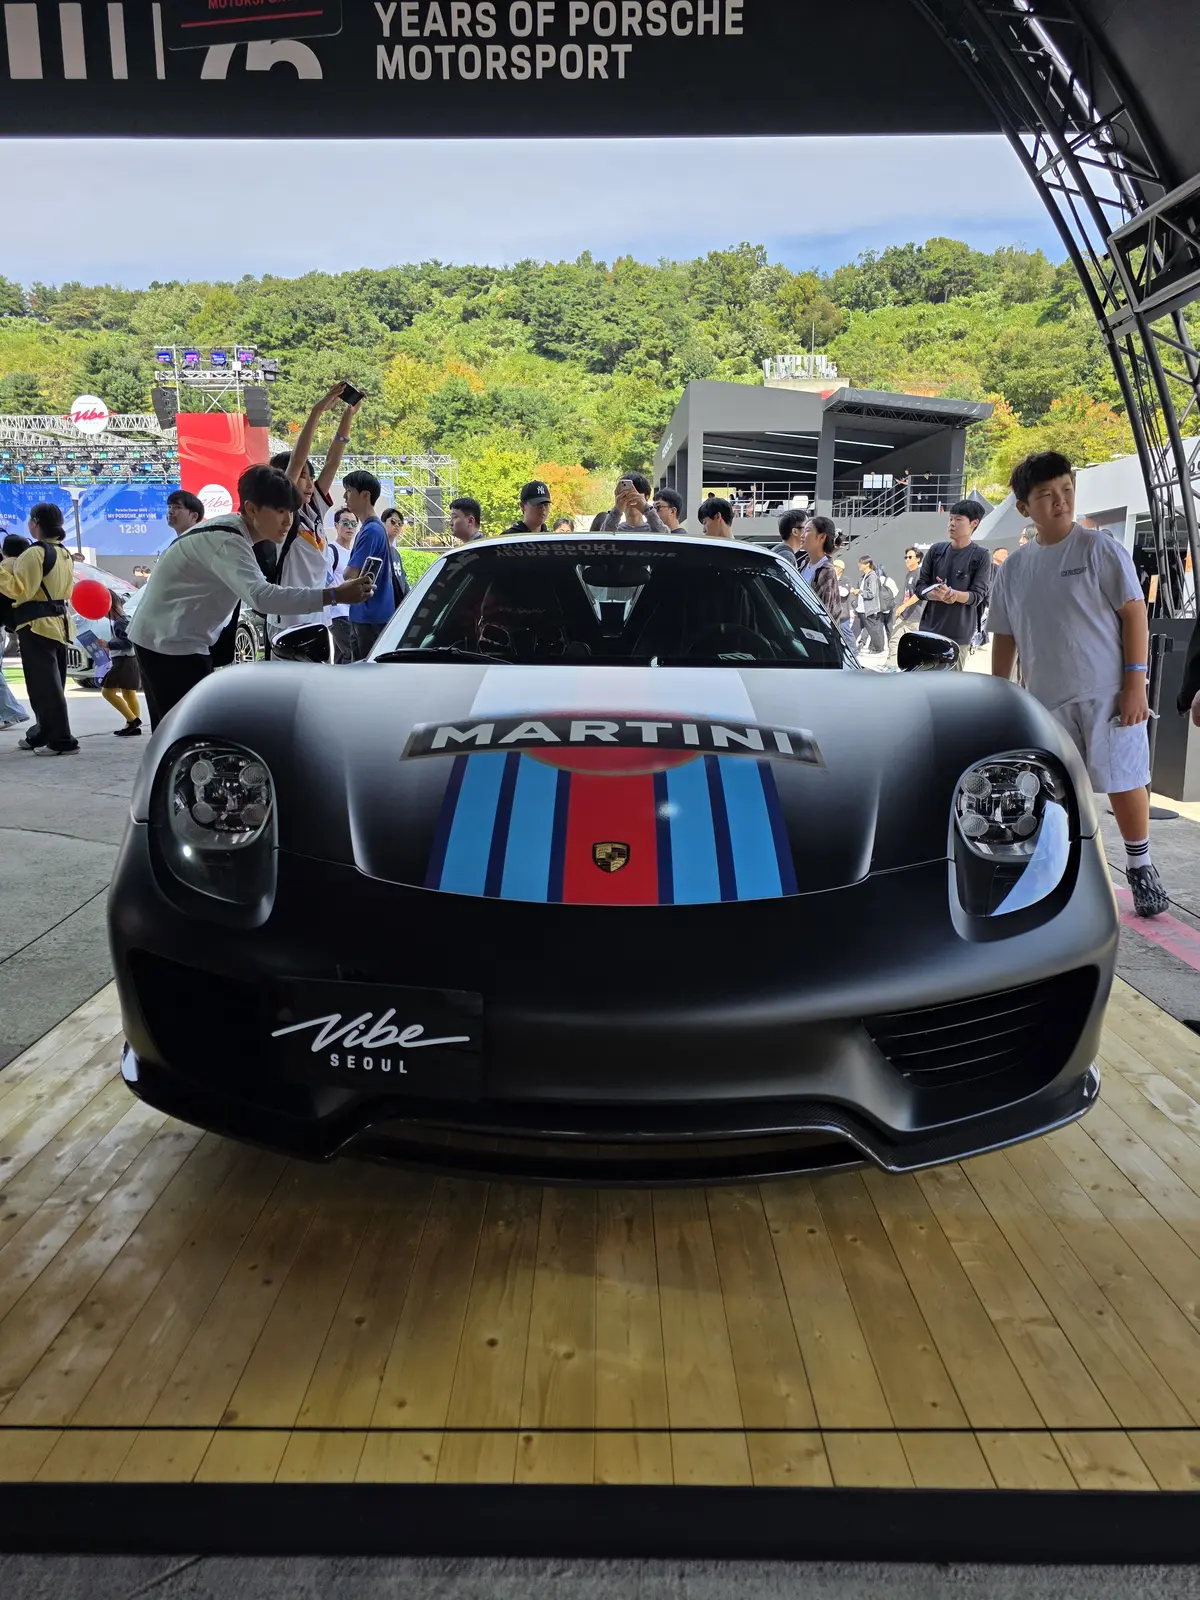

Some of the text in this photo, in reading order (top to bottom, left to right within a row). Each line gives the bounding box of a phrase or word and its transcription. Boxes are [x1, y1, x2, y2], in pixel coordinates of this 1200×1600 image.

[374, 0, 745, 37] YEARS OF PORSCHE
[376, 43, 633, 80] MOTORSPORT
[60, 408, 118, 423] Vibe
[119, 524, 147, 534] 12:30
[429, 720, 795, 755] MARTINI
[271, 1007, 470, 1052] Vibe
[330, 1053, 408, 1075] SEOUL
